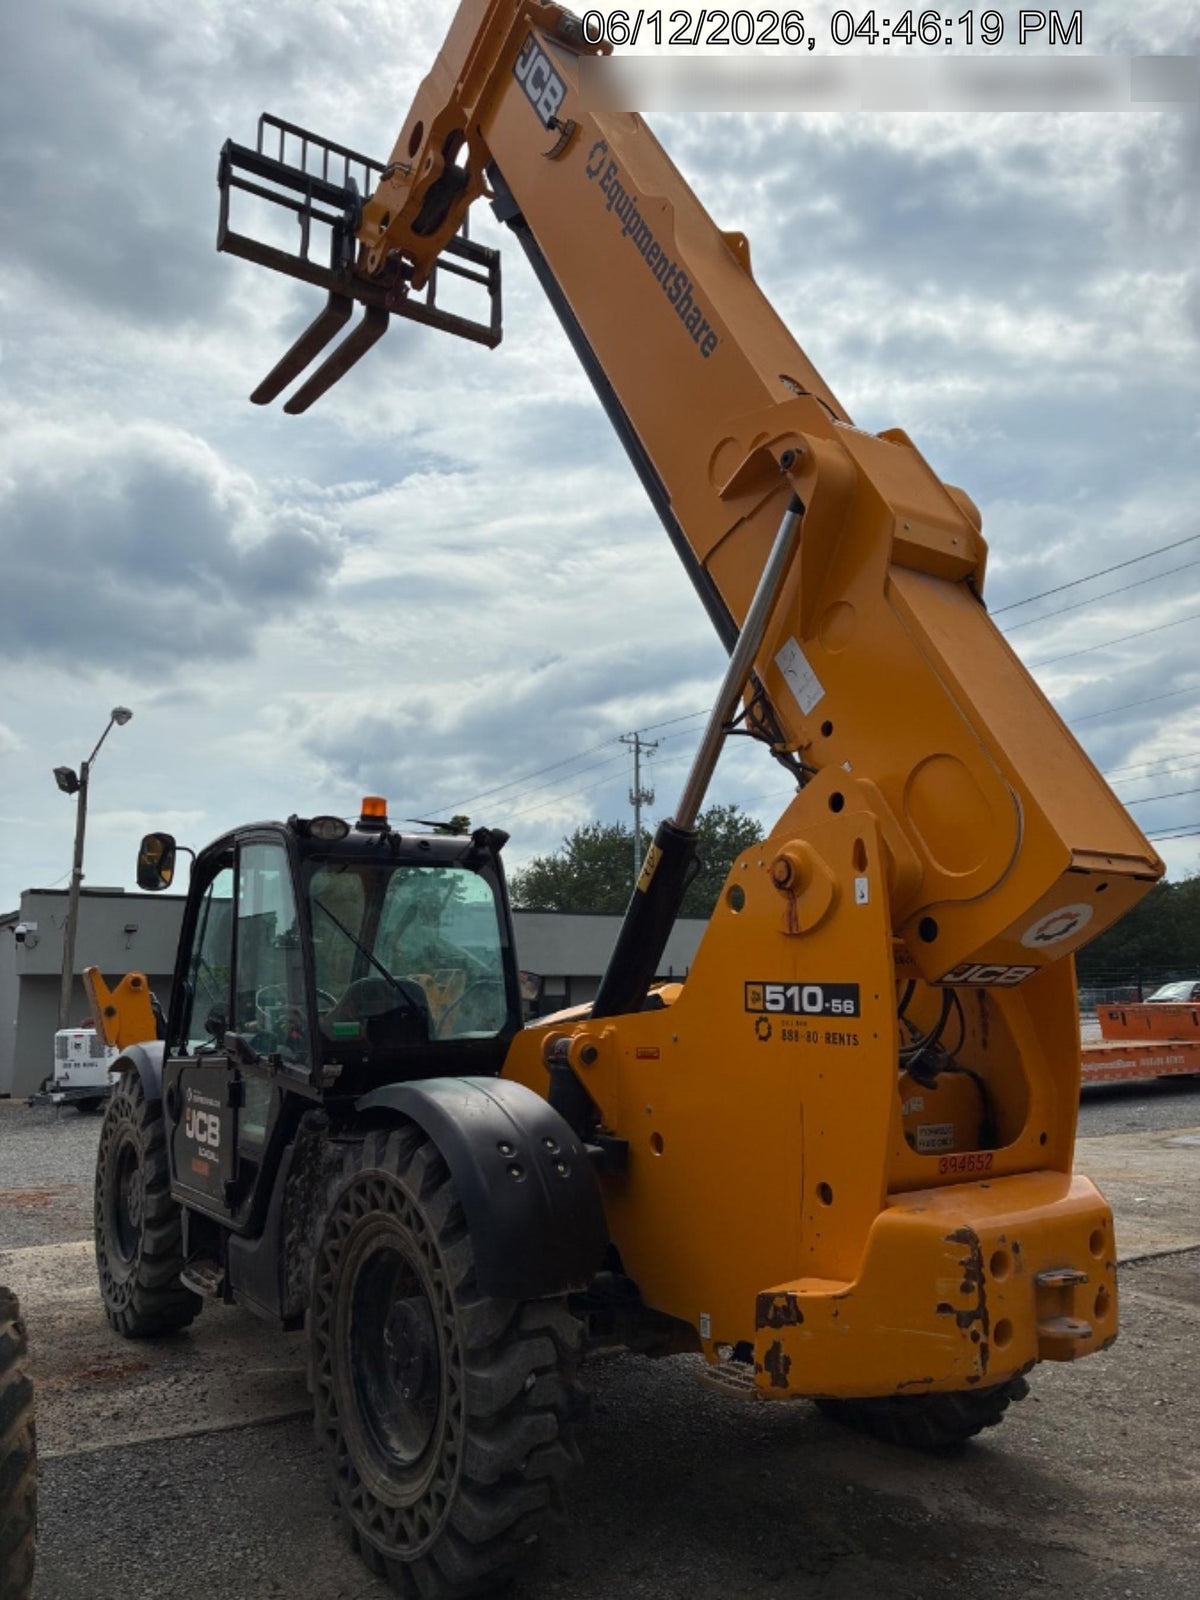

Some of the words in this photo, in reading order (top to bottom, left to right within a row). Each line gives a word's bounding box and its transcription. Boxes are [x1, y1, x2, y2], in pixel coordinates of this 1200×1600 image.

[514, 42, 564, 124] JCB
[599, 159, 719, 359] EquipmentShare
[946, 964, 1038, 983] JCB
[185, 1108, 220, 1148] JCB
[939, 1152, 994, 1175] 394652
